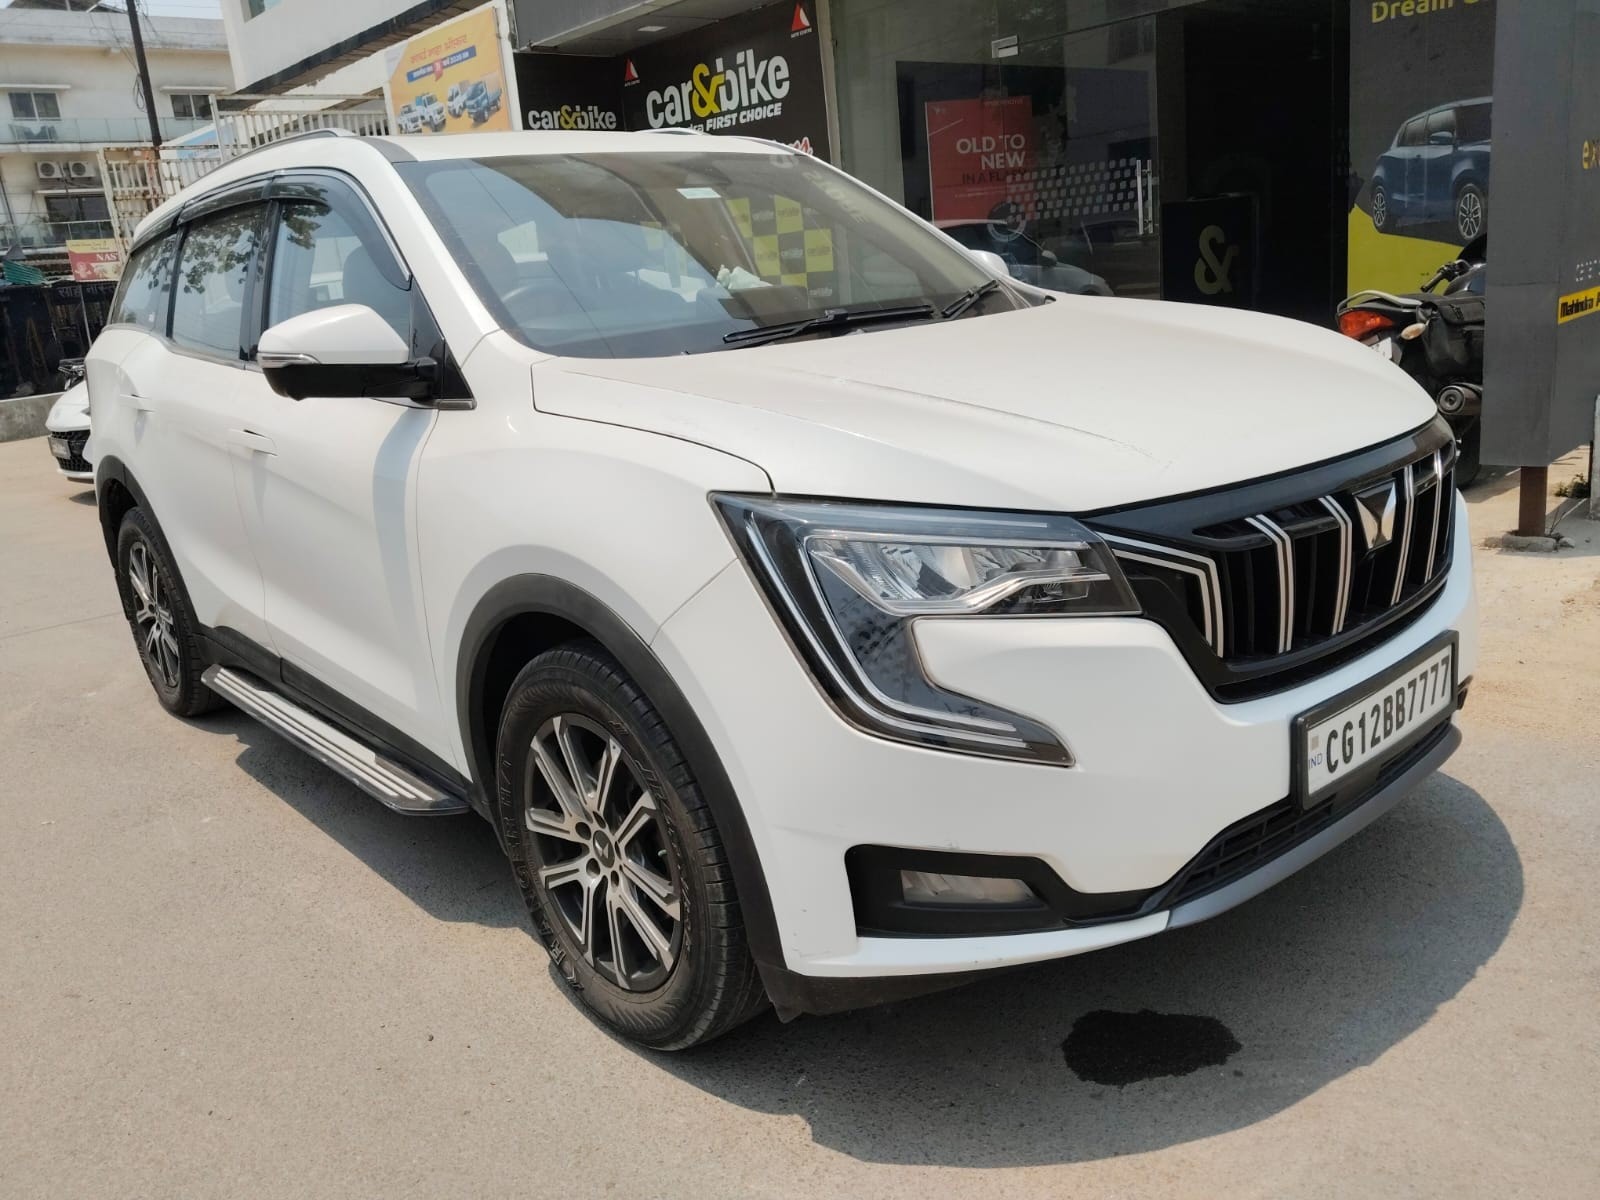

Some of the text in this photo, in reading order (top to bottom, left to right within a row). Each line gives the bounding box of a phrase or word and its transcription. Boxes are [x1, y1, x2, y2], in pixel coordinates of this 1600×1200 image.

[646, 49, 790, 128] car&bike
[528, 105, 617, 130] car&bike
[706, 113, 738, 132] FIRST
[739, 102, 783, 124] CHOICE
[956, 134, 1026, 154] OLD TO
[981, 151, 1026, 170] NEW
[1326, 655, 1450, 774] CG12BB7777
[1308, 753, 1323, 769] IND
